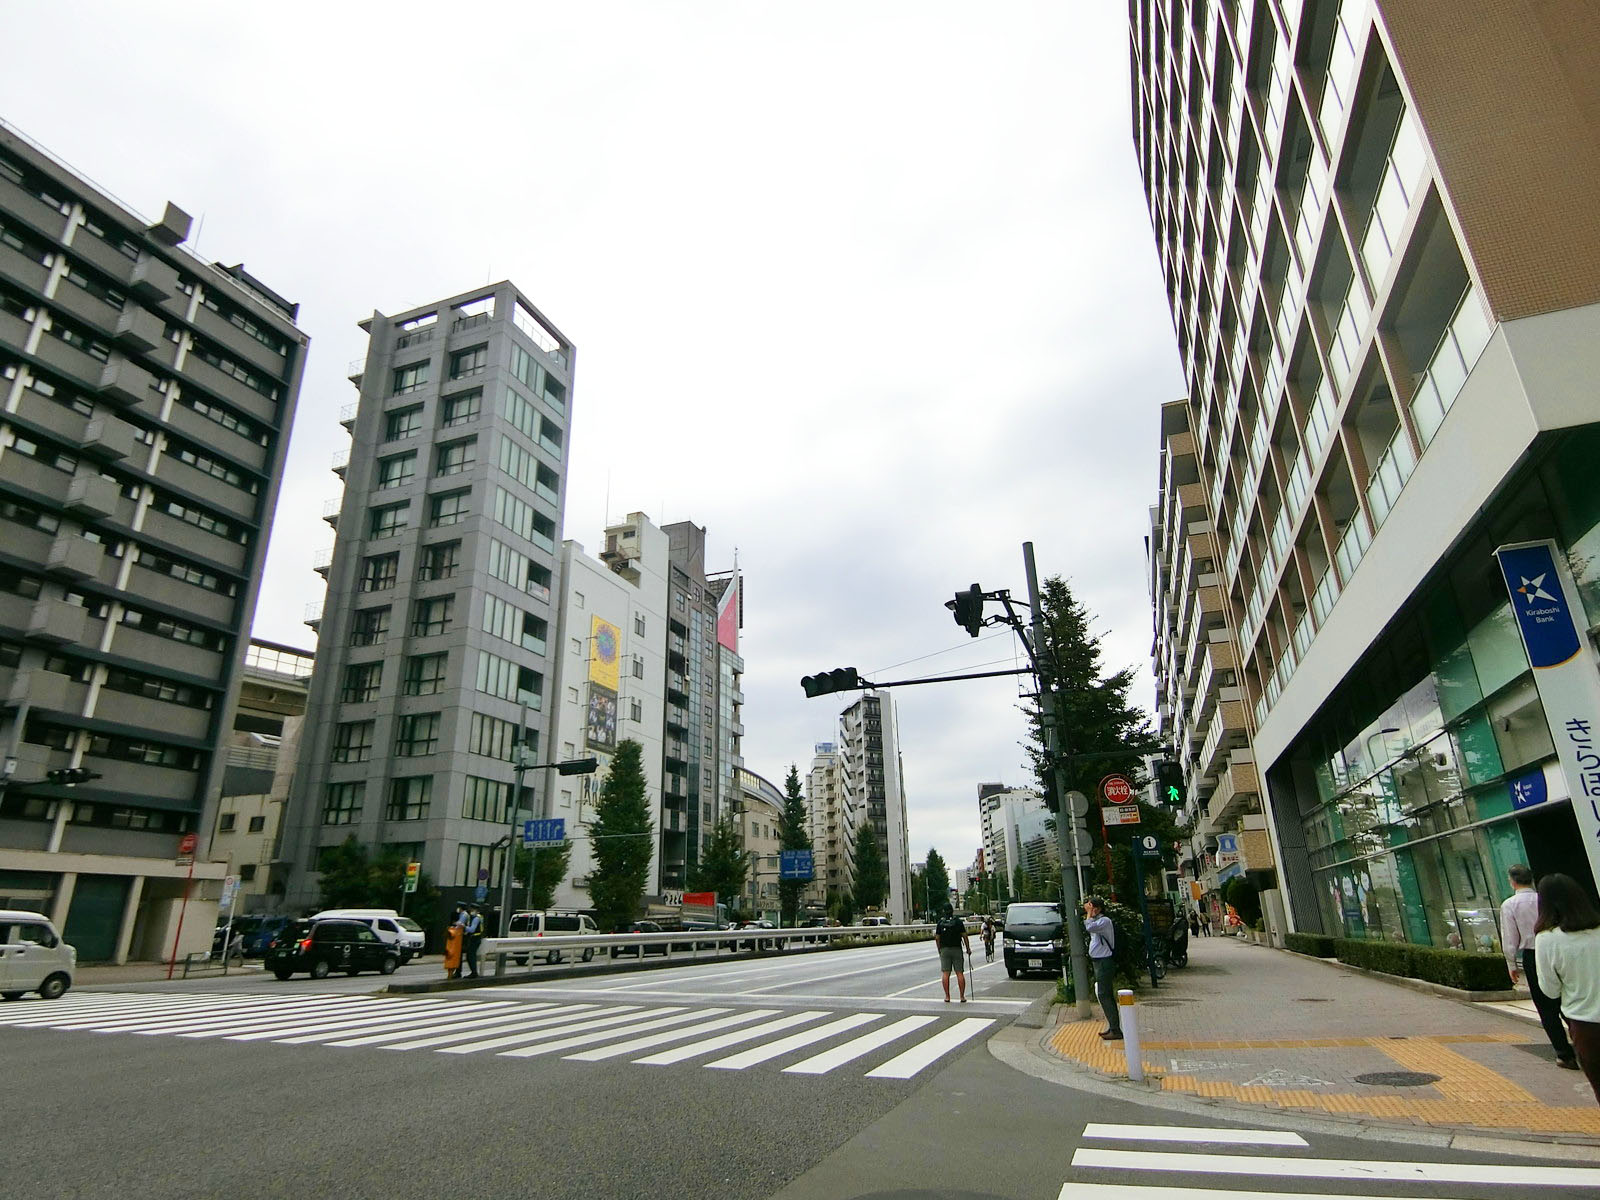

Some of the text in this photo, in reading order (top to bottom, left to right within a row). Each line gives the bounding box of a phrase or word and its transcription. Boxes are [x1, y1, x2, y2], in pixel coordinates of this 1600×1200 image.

[1525, 607, 1560, 616] Kiraboshi
[1535, 616, 1555, 624] Bank
[1106, 784, 1129, 796] 消火栓
